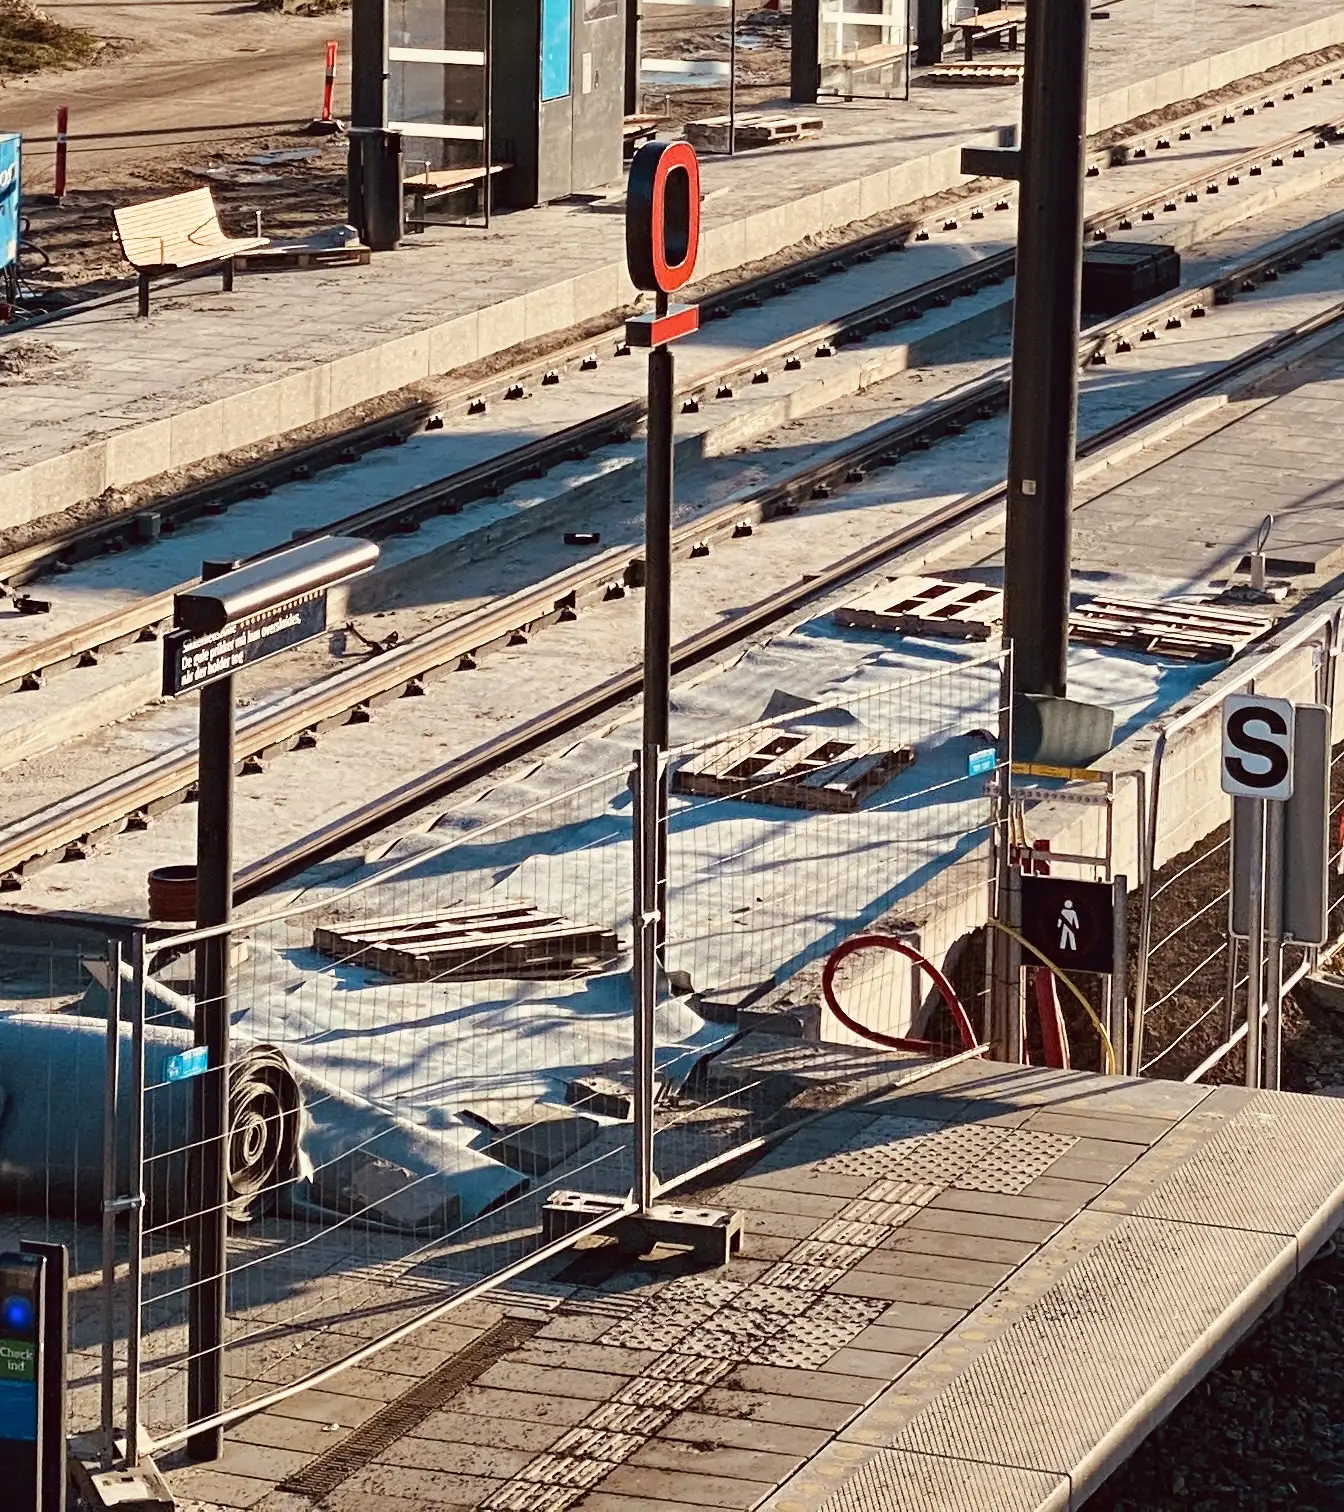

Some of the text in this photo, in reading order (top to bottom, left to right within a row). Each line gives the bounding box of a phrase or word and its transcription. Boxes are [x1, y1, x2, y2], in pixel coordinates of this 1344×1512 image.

[180, 656, 192, 671] De
[194, 666, 207, 681] der
[207, 657, 231, 676] holder
[1225, 706, 1288, 788] S
[0, 1345, 33, 1361] Check
[7, 1359, 25, 1372] ind
